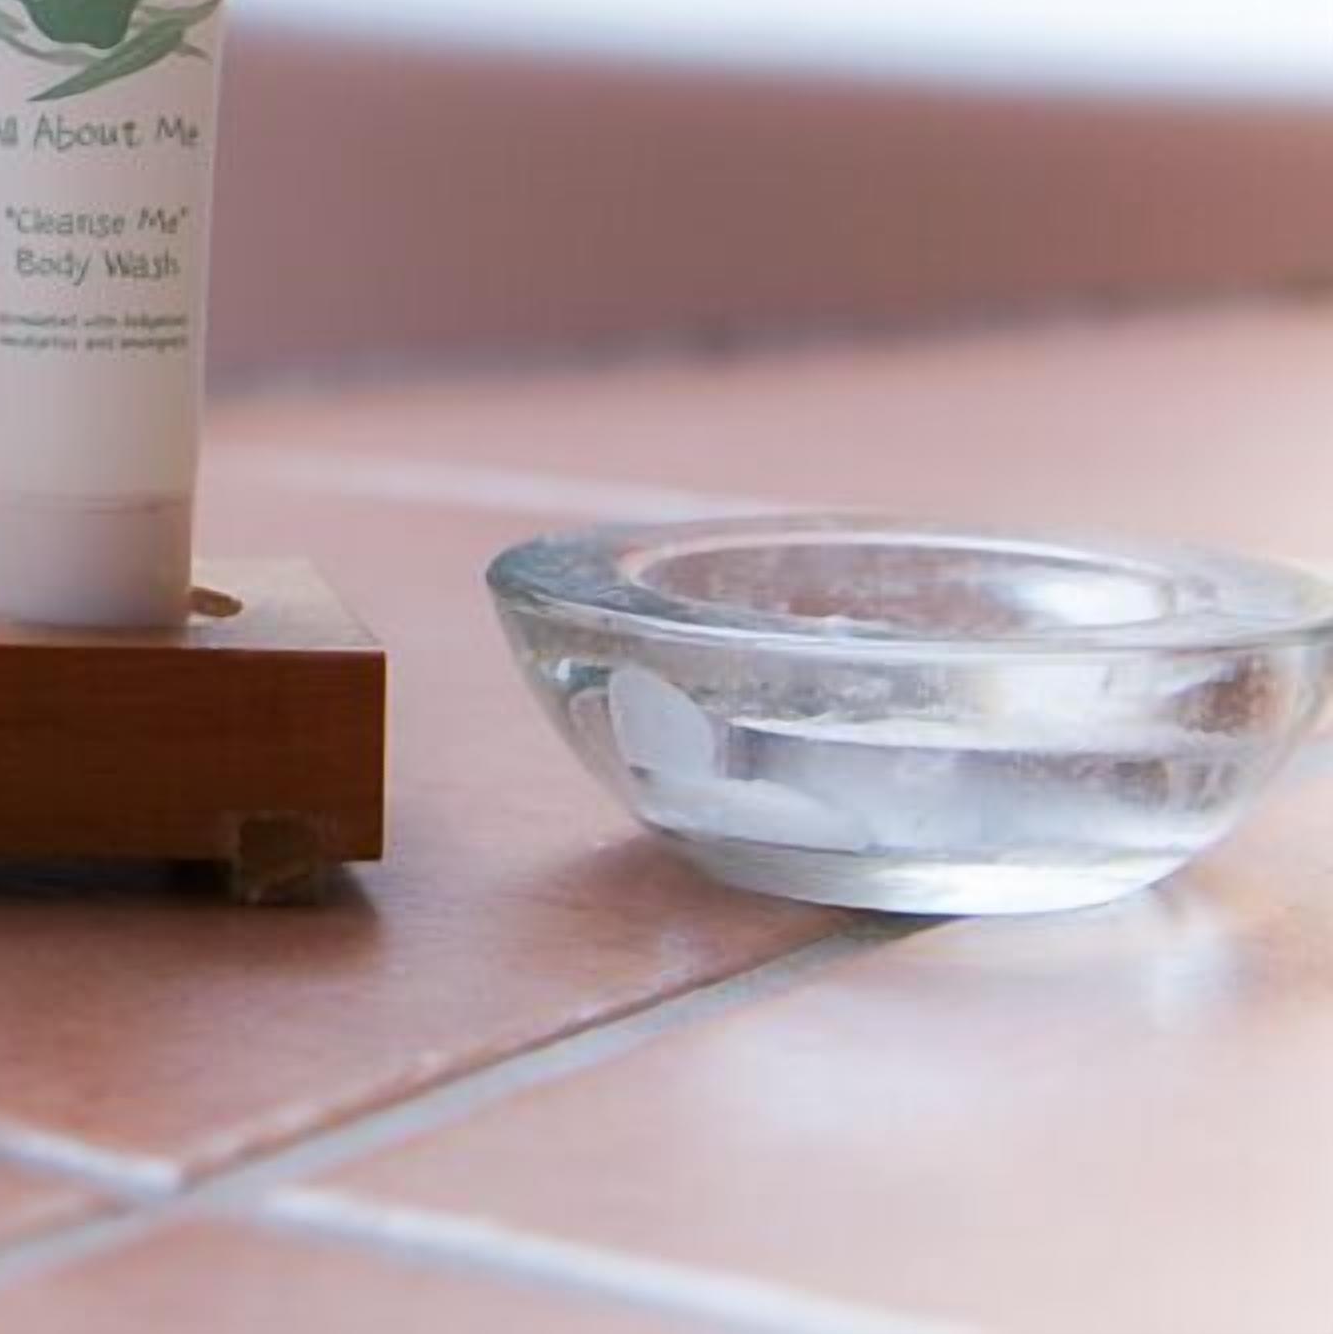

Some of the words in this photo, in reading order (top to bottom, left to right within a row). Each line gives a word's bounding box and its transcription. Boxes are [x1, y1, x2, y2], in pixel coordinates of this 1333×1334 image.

[32, 113, 141, 153] About
[155, 116, 200, 148] Me
[15, 249, 92, 287] Body
[103, 249, 182, 280] Wash
